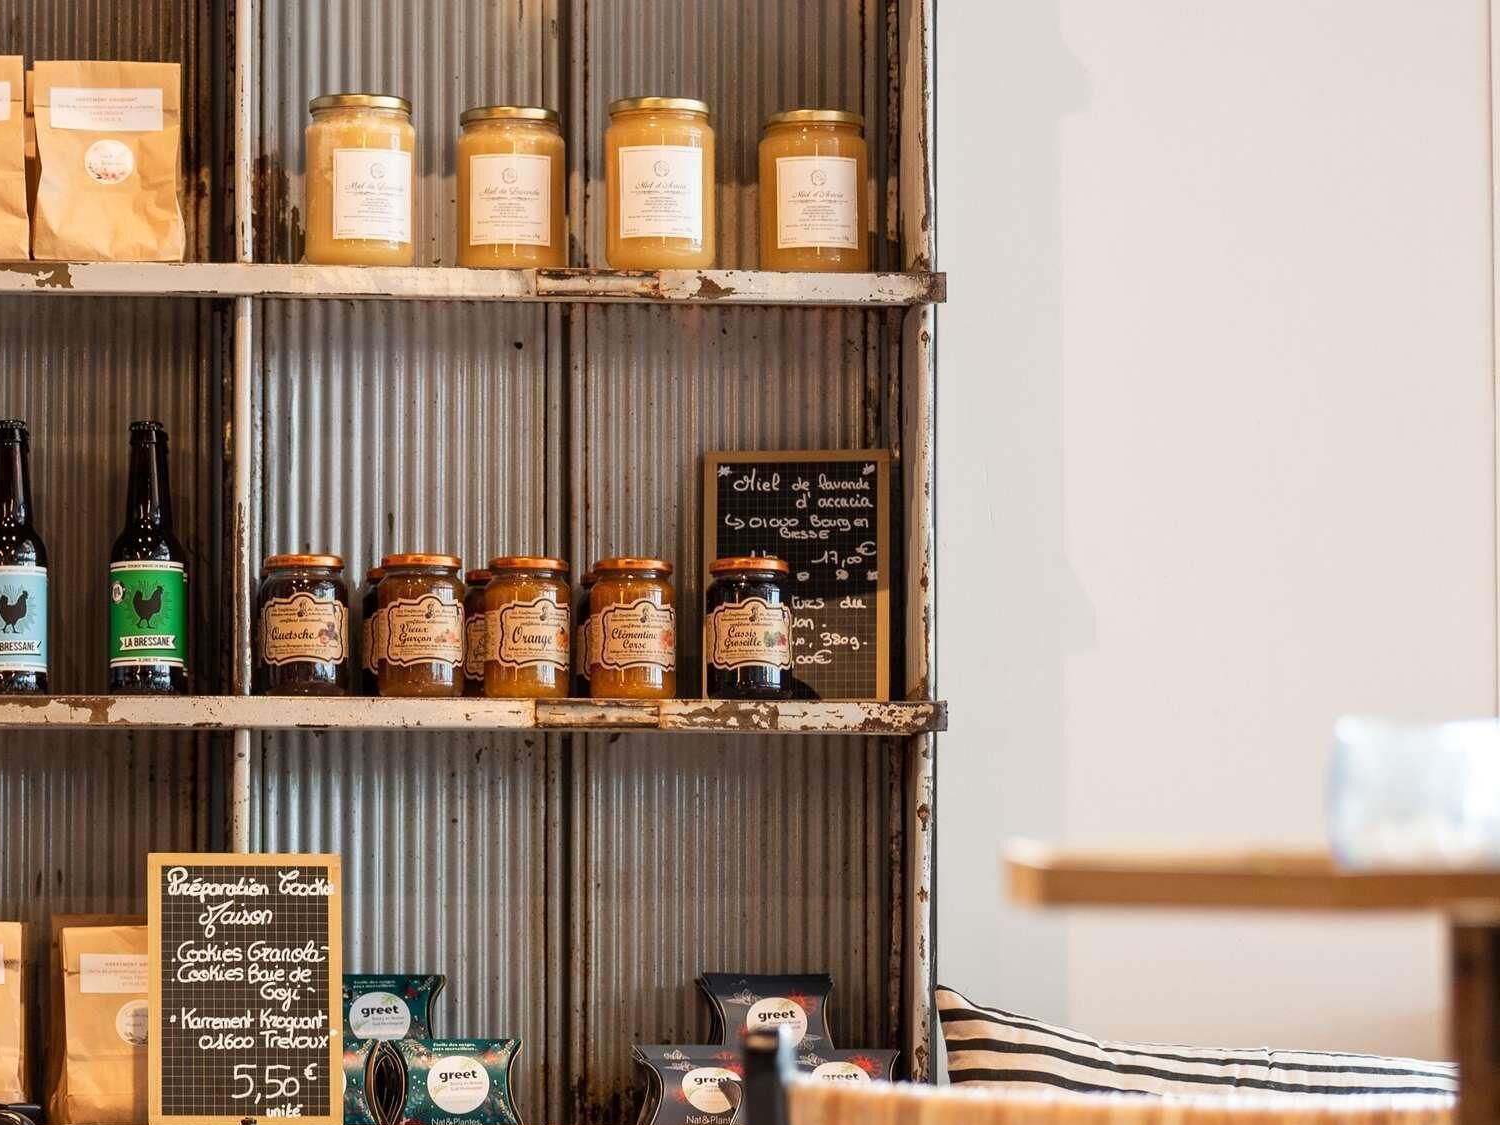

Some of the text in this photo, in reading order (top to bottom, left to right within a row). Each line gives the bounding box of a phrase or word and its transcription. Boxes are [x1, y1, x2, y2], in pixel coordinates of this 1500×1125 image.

[733, 468, 870, 491] Miel de lavande
[810, 514, 851, 532] Bourg
[853, 518, 869, 529] en
[271, 626, 315, 641] Quetsche
[399, 623, 429, 633] Vieux
[512, 625, 552, 647] Orange
[727, 626, 757, 638] Cassis
[0, 641, 36, 652] BRESSANE
[124, 636, 170, 648] LA BRESSANE
[622, 639, 646, 649] Corse
[723, 637, 763, 649] Groseille
[167, 866, 270, 903] Préparation
[198, 899, 273, 939] Maison
[177, 940, 327, 963] Cookies Granola
[177, 962, 312, 985] Cookies Baie de
[259, 981, 301, 1012] Goji
[360, 1004, 400, 1018] greet
[757, 1009, 796, 1022] greet
[181, 1006, 328, 1034] Karrement Kroquant
[198, 1032, 255, 1050] 01600
[439, 1069, 478, 1083] greet
